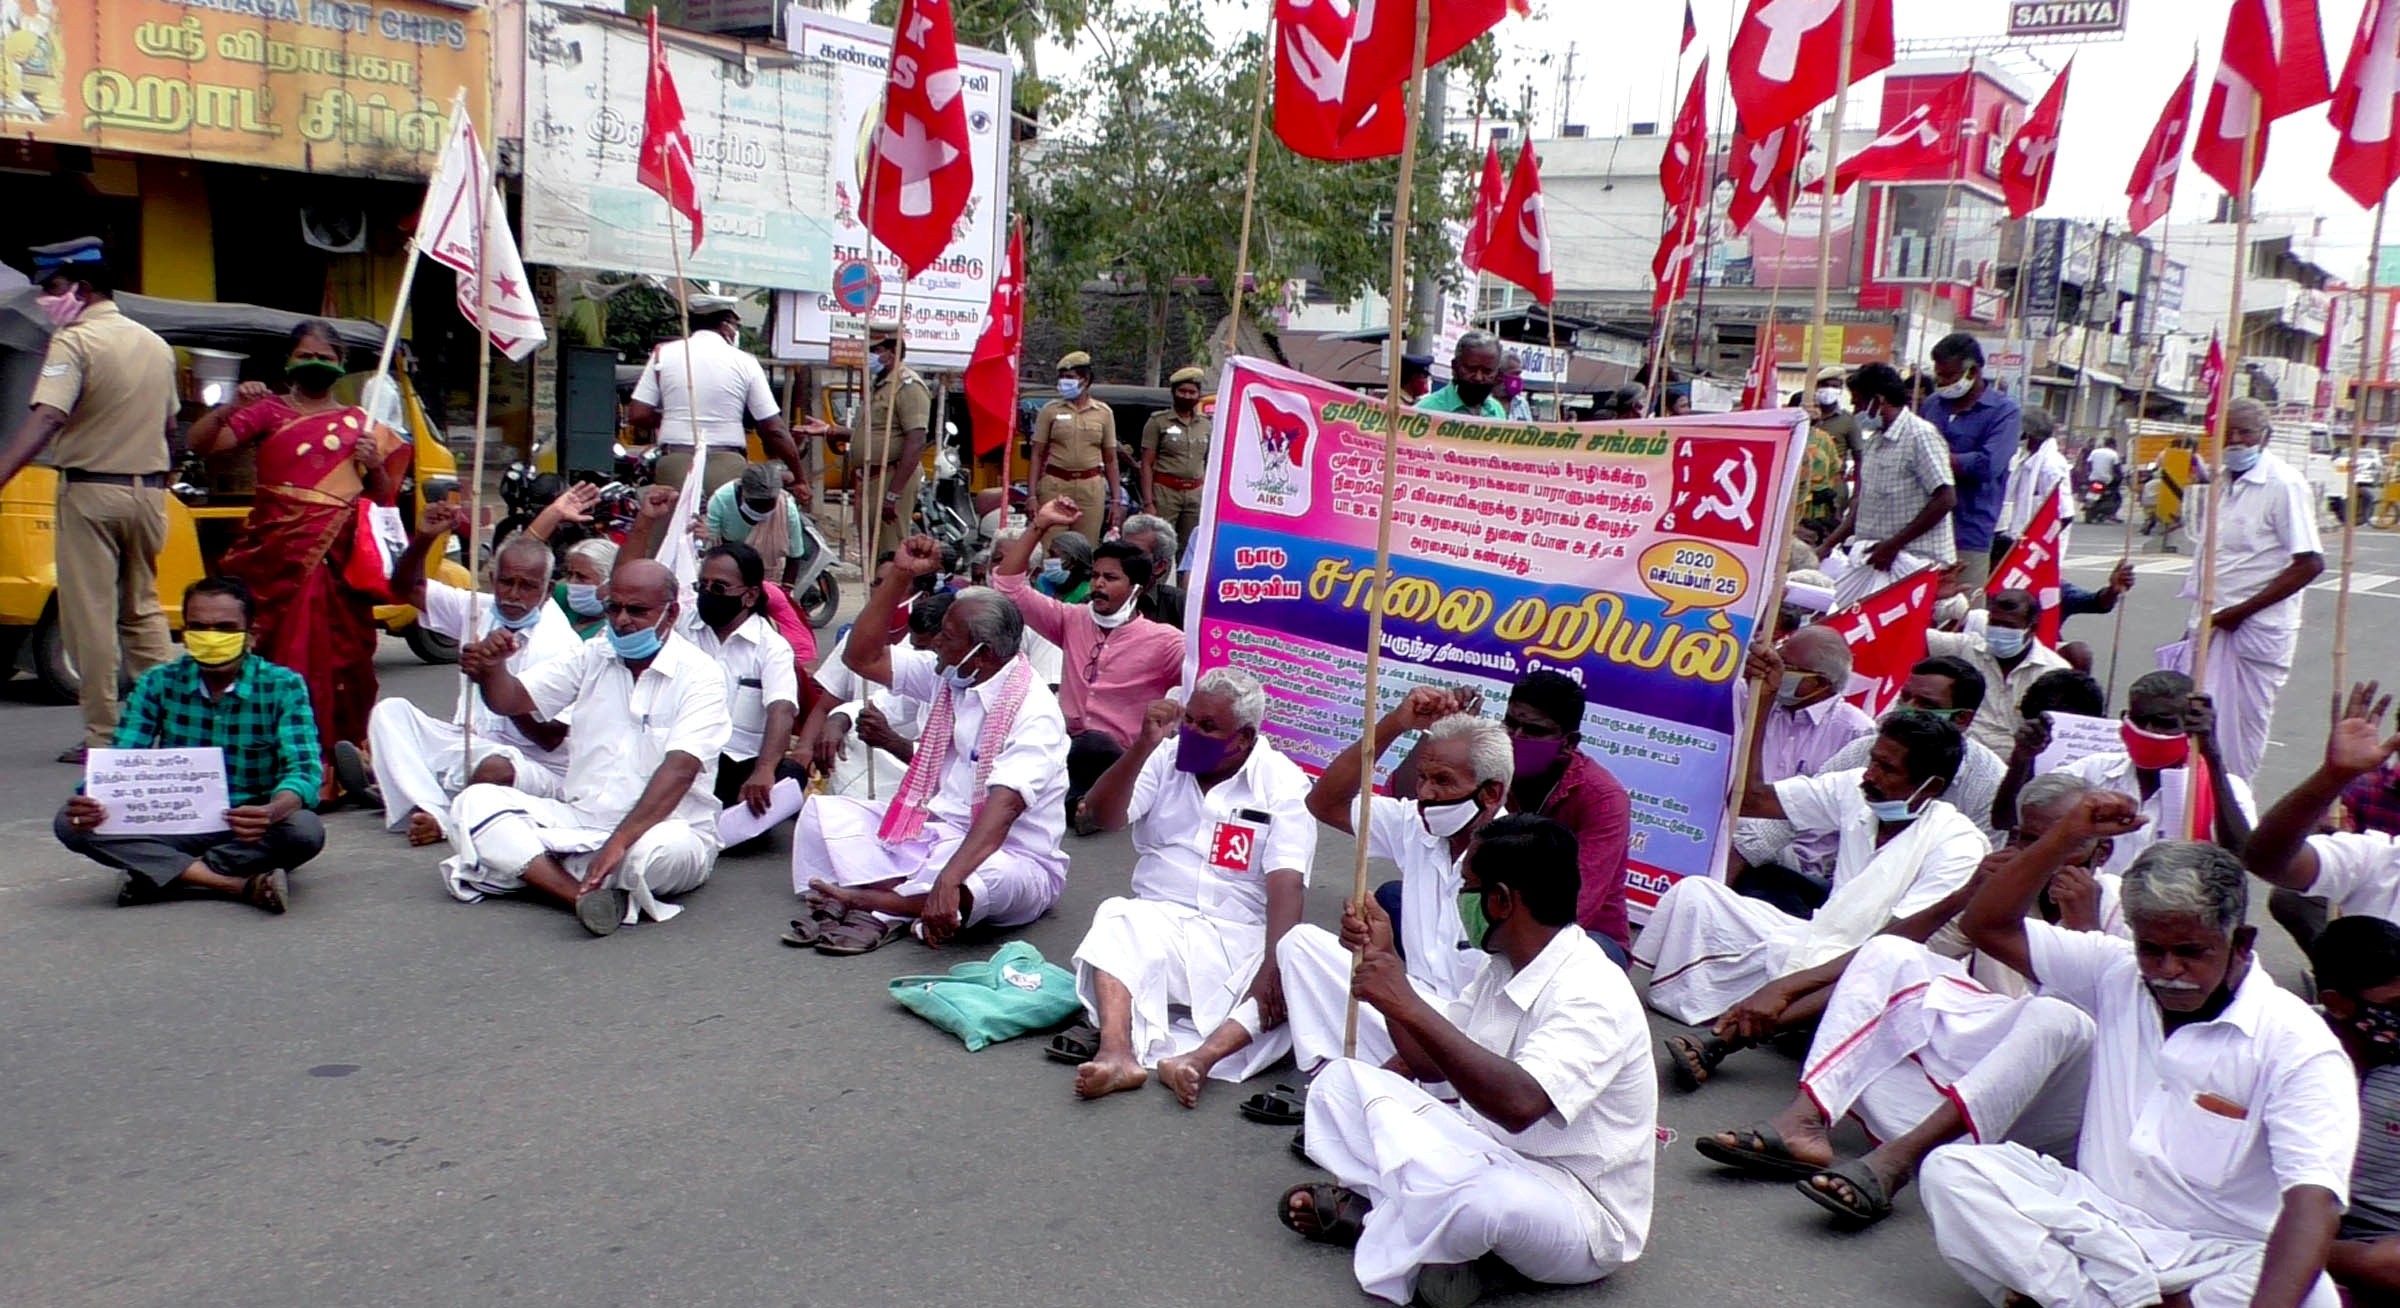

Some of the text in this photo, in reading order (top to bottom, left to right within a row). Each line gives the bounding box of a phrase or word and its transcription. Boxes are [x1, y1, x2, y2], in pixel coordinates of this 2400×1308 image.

[307, 1, 370, 35] HOT
[379, 8, 466, 51] CHIPS
[2016, 2, 2114, 26] SATHYA
[1437, 419, 1583, 449] விவசாயிகள்
[1586, 429, 1669, 455] சங்கம்
[1332, 452, 1373, 475] மூன்று
[1534, 486, 1653, 512] பாராளுமன்றத்தில்
[1256, 492, 1285, 506] AIKS
[1411, 487, 1517, 519] விவசாயிகளுக்கு
[1522, 508, 1580, 526] துரோகம்
[1420, 514, 1482, 537] அரசையும்
[1485, 527, 1528, 543] துணை
[1531, 533, 1568, 551] போன
[1237, 549, 1286, 567] நாடு
[1410, 536, 1469, 559] அரசையும்
[1675, 550, 1714, 569] 2020
[1220, 577, 1301, 601] தழுவிய
[1650, 566, 1736, 594] செப்டம்பர் 25
[1308, 558, 1739, 683] சாலை மறியல்
